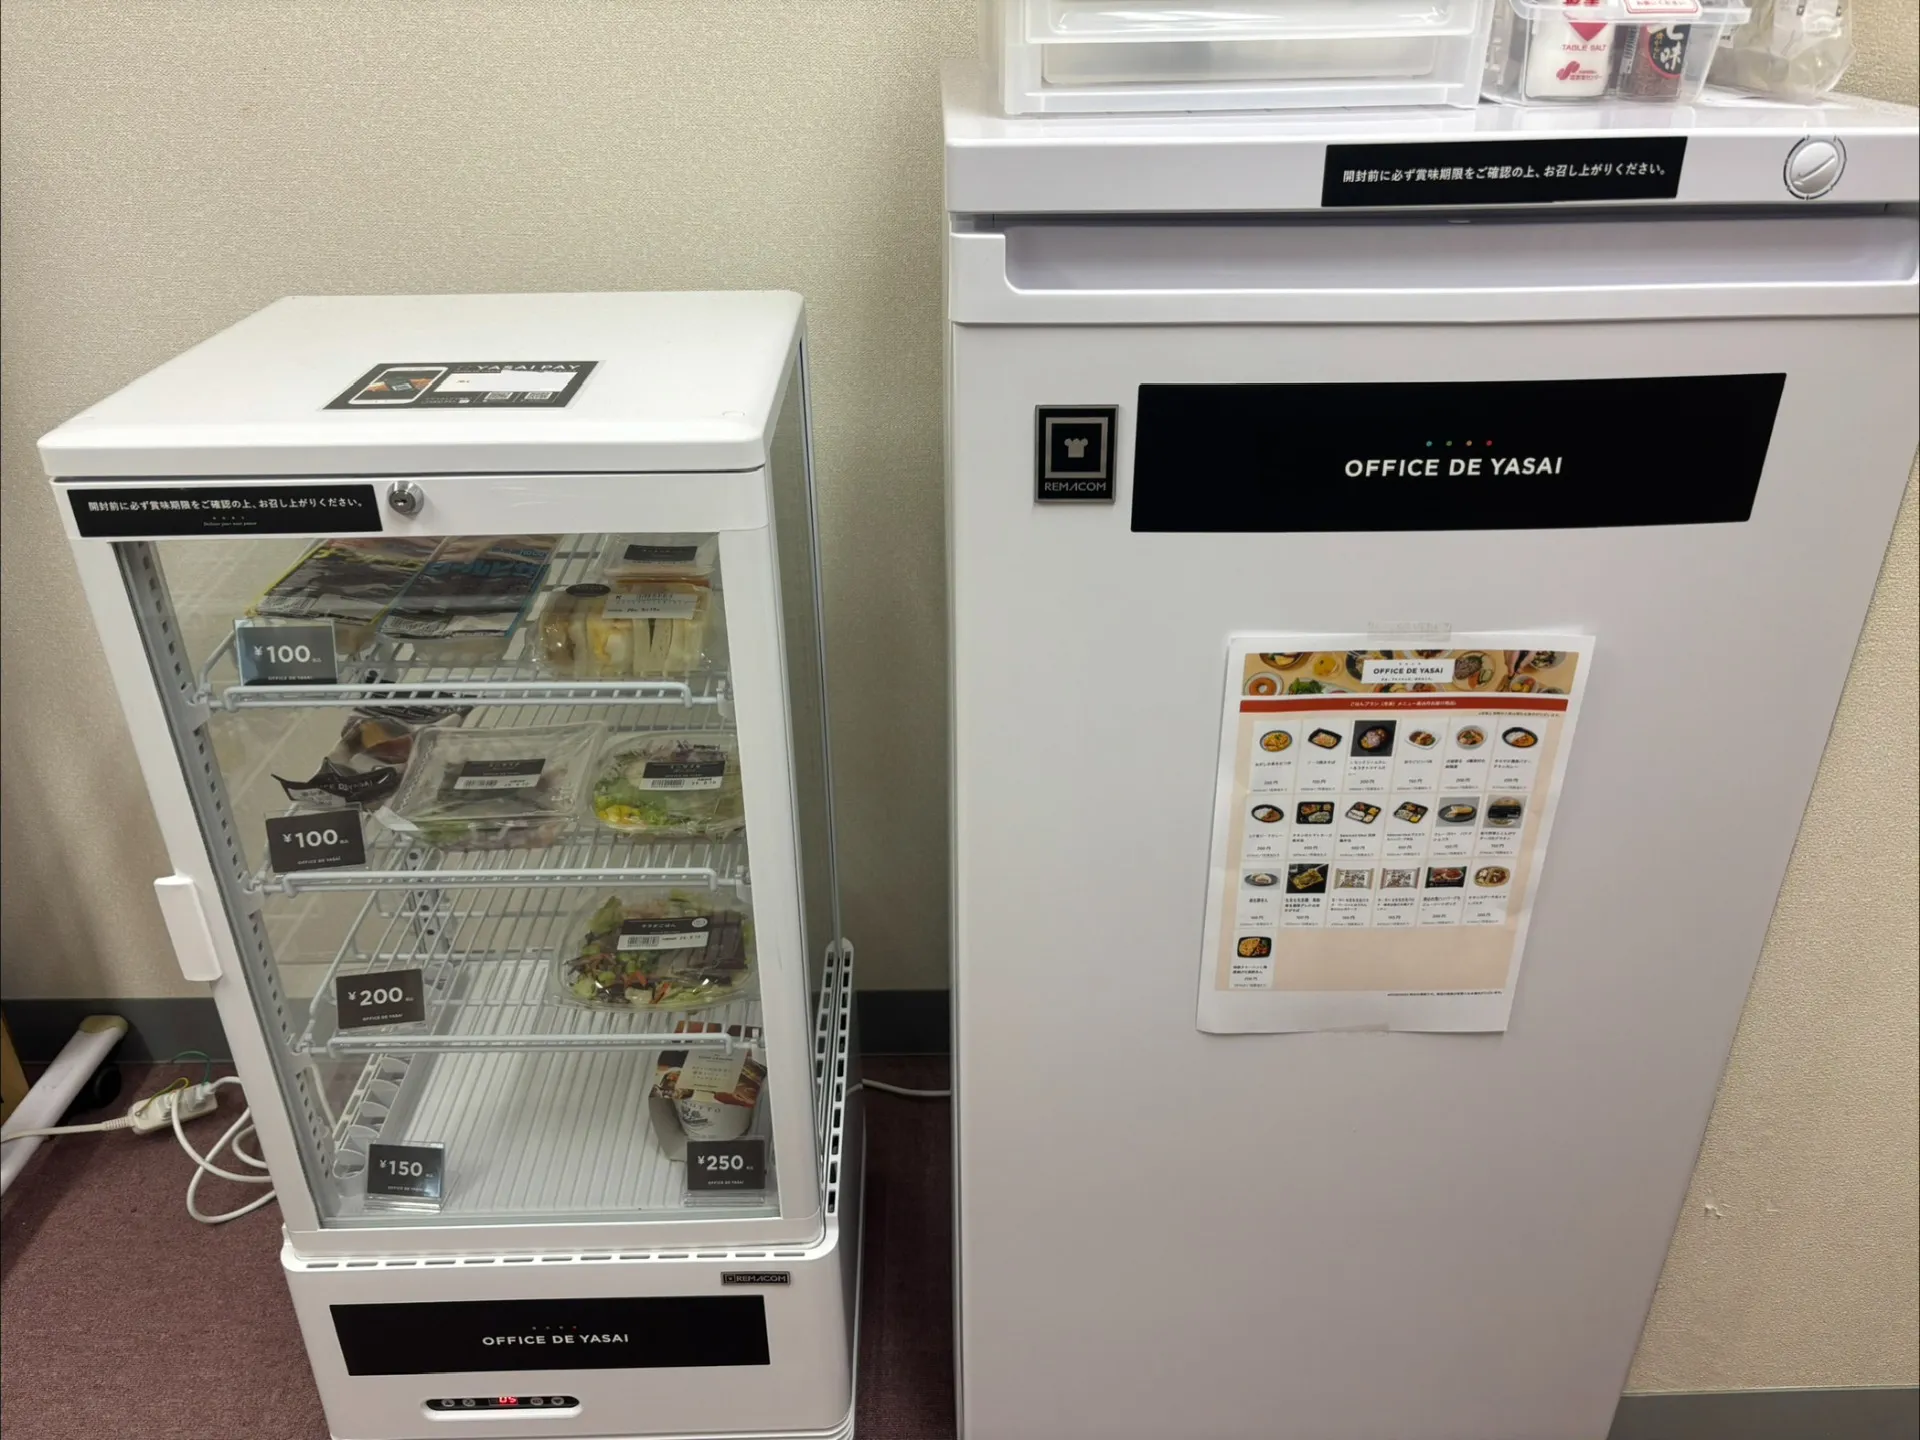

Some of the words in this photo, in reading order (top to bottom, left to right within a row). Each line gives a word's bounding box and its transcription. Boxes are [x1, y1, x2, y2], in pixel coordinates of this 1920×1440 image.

[1562, 44, 1588, 52] TABLE
[1590, 44, 1607, 52] SALT
[1342, 163, 1667, 183] 開封前に必ず賞味期限をご確認の上、お召し上がりください。
[1344, 458, 1440, 478] OFFICE
[1448, 458, 1482, 476] DE
[1491, 456, 1563, 476] YASAI
[1044, 481, 1107, 492] REMACOM
[88, 498, 363, 512] 開封前に必ず賞味期限をご確認の上、お召し上がりください。
[254, 645, 311, 664] ¥100
[1373, 667, 1404, 675] OFFICE
[282, 829, 338, 848] ¥100
[348, 986, 403, 1006] ¥200
[380, 1159, 423, 1177] ¥150
[697, 1154, 744, 1171] ¥250
[482, 1335, 546, 1346] OFFICE
[552, 1334, 575, 1345] DE
[580, 1333, 629, 1344] YASAI
